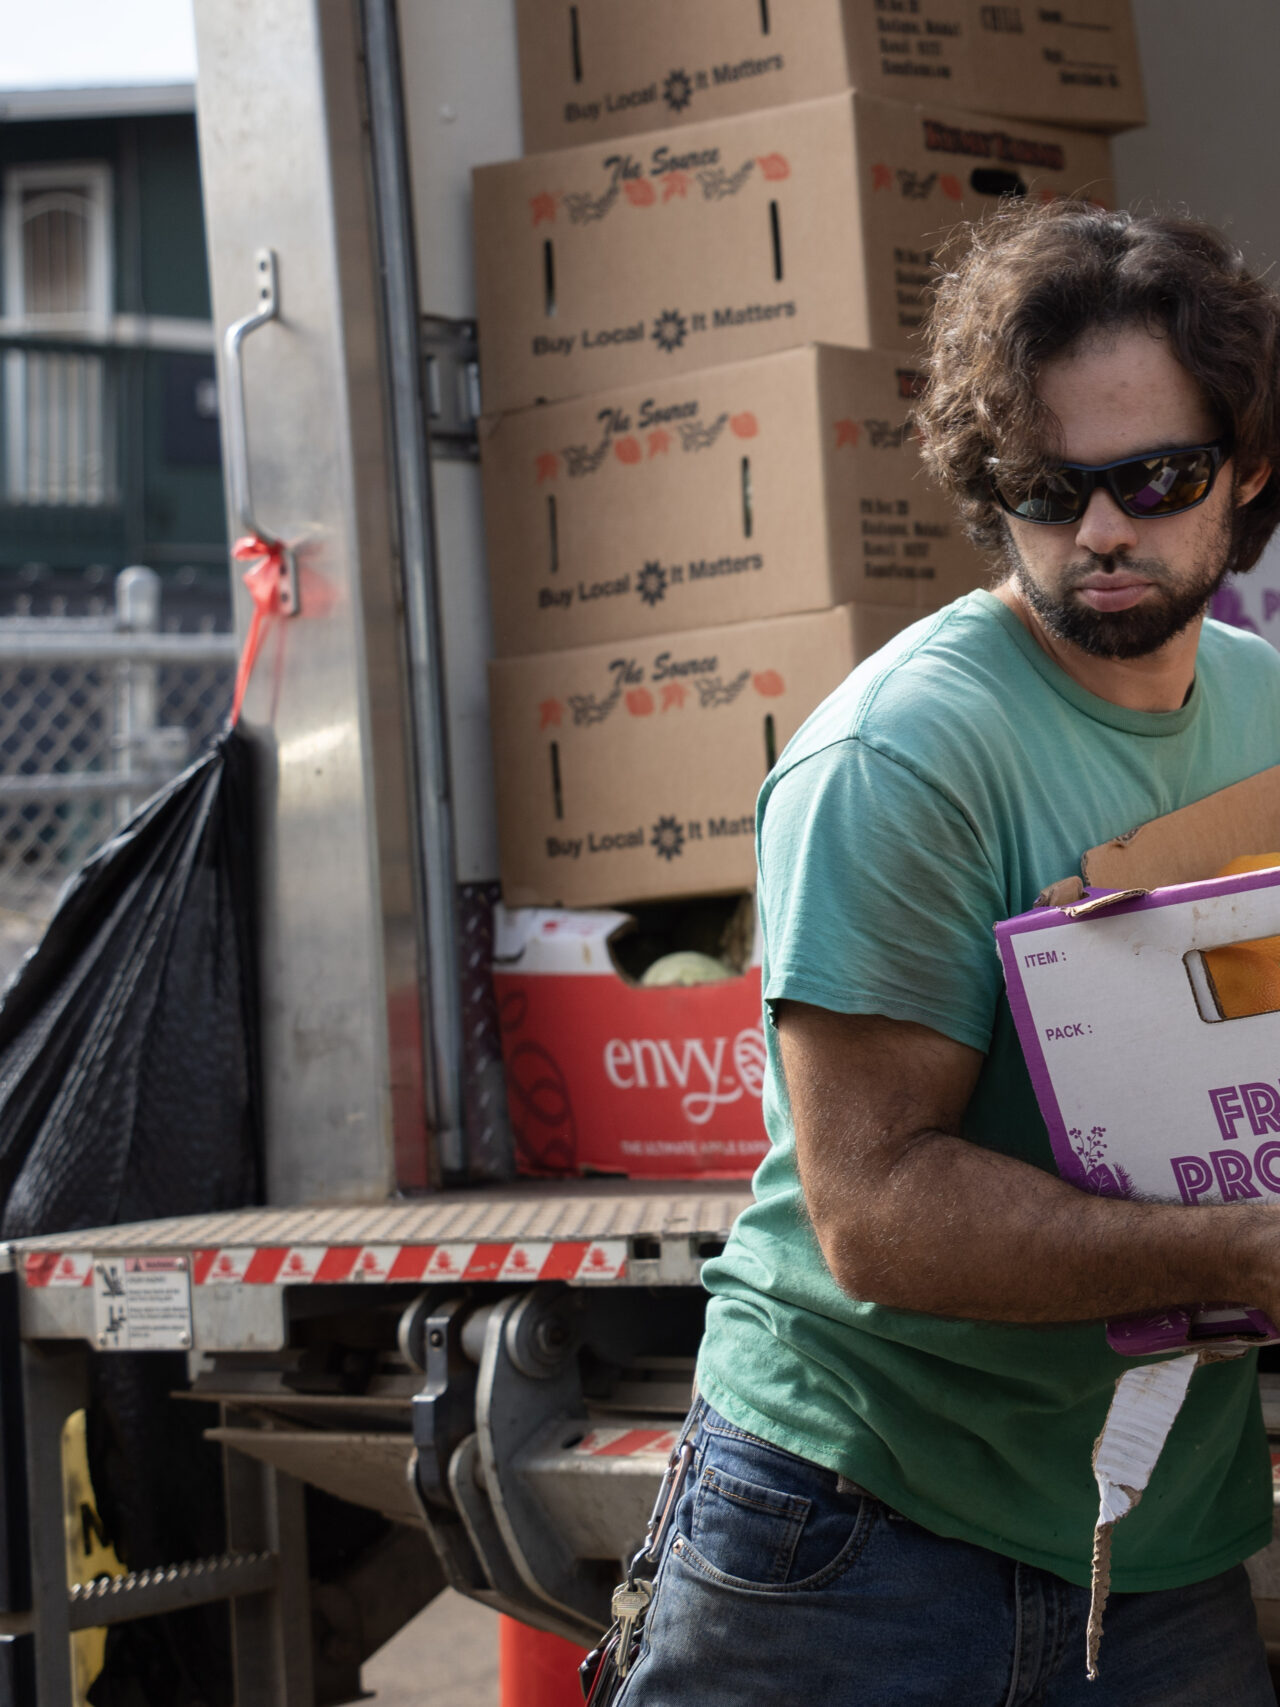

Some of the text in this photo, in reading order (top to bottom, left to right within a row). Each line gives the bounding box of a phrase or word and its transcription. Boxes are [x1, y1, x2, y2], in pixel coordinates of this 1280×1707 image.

[605, 83, 657, 113] Local
[712, 54, 784, 85] Matters
[604, 146, 719, 183] The Source
[532, 301, 796, 357] Buy Local It Matters
[597, 398, 698, 434] The Source
[538, 553, 763, 608] Buy Local It Matters
[609, 652, 718, 686] The Source
[546, 815, 757, 859] Buy Local It Matt
[604, 1037, 744, 1125] envy
